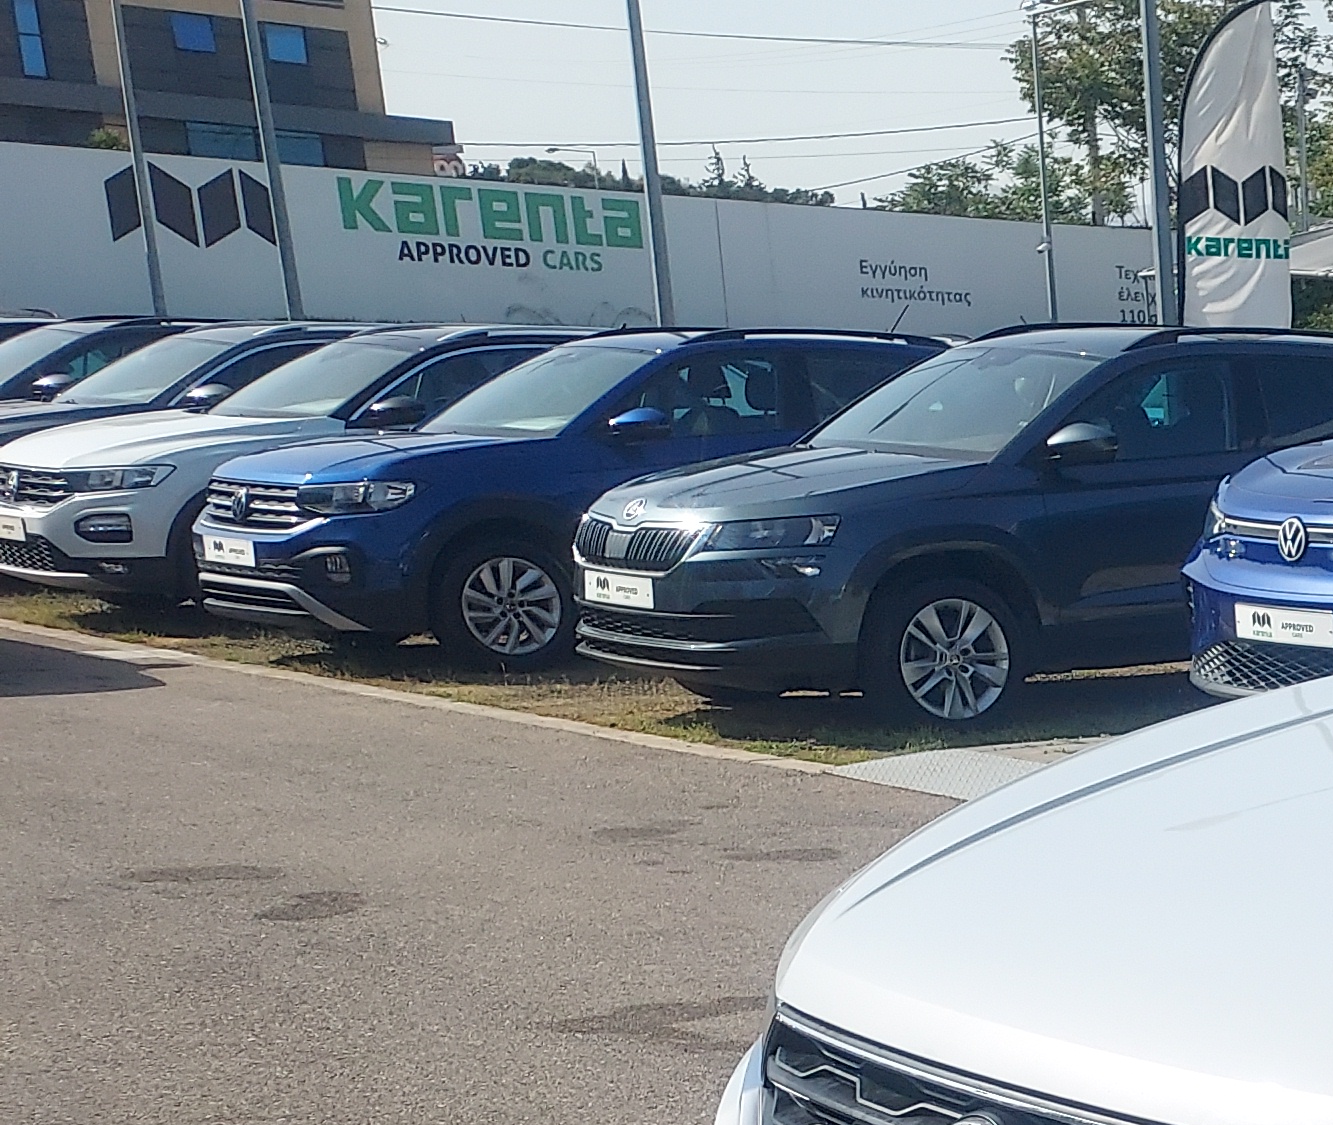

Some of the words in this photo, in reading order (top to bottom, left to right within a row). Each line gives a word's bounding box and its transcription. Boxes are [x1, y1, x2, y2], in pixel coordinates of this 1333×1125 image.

[336, 176, 643, 248] karenta
[398, 240, 531, 268] APPROVED
[542, 249, 603, 272] CARS
[858, 259, 928, 281] Εγγύηση
[861, 284, 971, 305] κινητικότητας
[1120, 309, 1146, 324] 110
